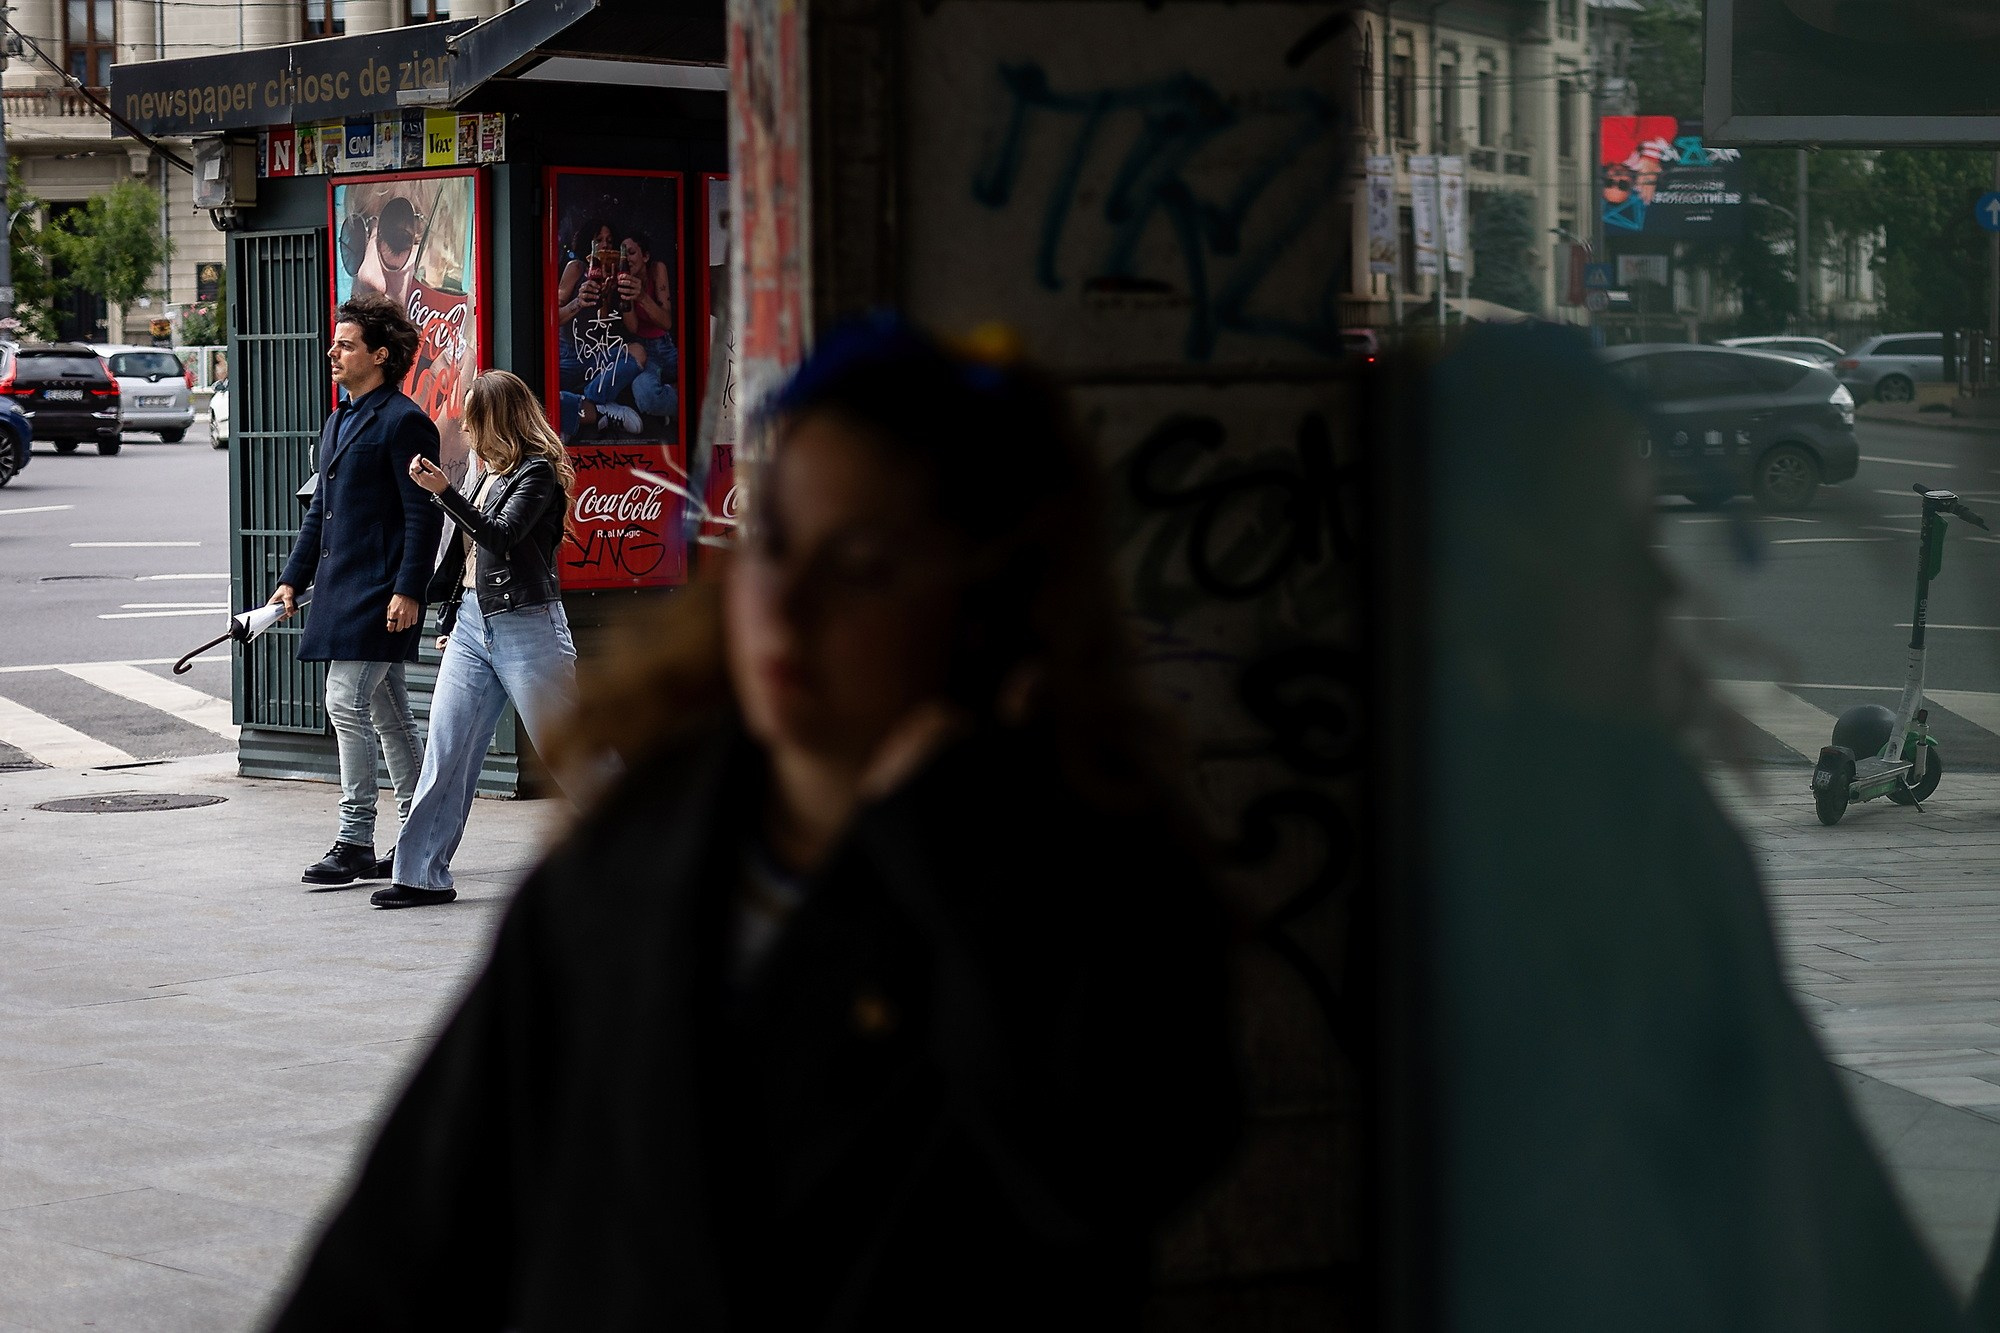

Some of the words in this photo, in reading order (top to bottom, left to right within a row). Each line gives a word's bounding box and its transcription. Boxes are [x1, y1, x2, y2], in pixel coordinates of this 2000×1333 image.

[125, 80, 258, 125] newspaper
[264, 68, 350, 108] chiosc
[358, 57, 392, 97] de
[398, 50, 449, 90] ziar
[273, 139, 291, 171] N
[348, 135, 371, 155] CNN
[428, 133, 453, 154] Vox
[574, 484, 666, 522] Coca-Cola
